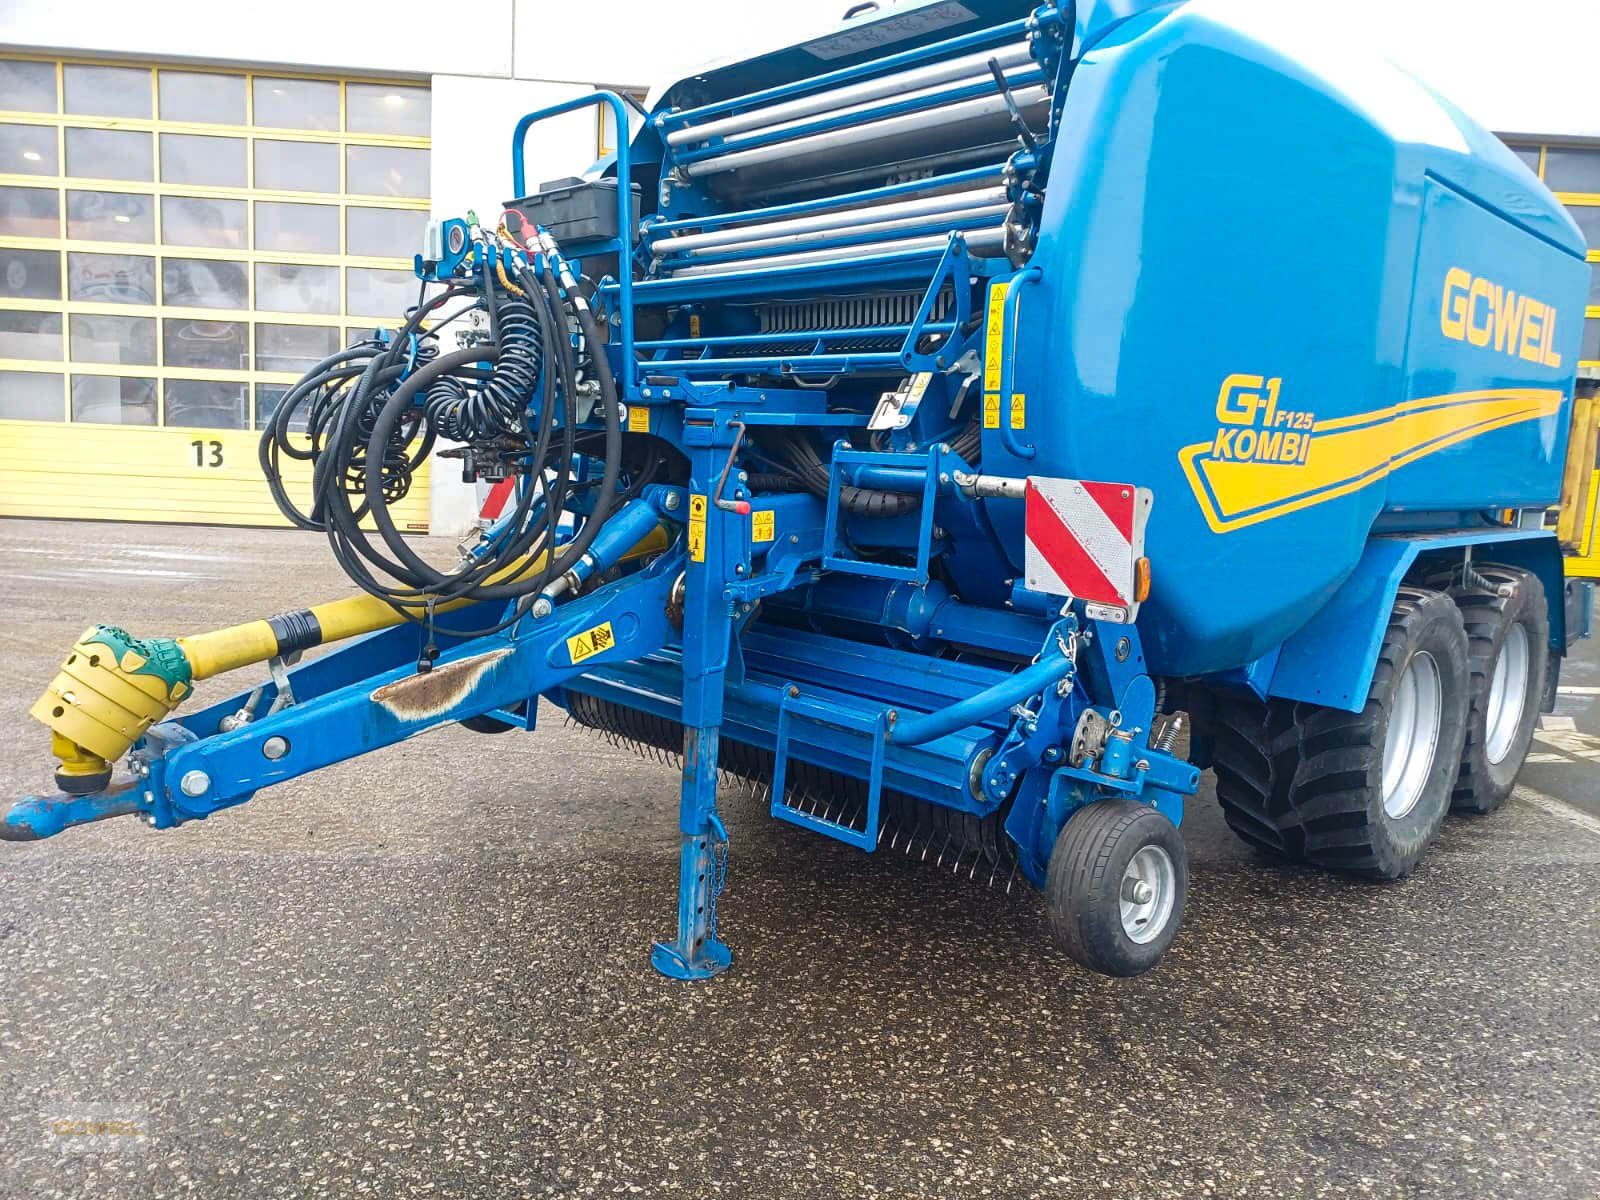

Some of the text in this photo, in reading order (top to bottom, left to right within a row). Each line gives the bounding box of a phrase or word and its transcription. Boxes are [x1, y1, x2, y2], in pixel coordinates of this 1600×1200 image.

[1275, 410, 1314, 429] F125
[192, 440, 223, 467] 13
[1213, 428, 1309, 462] KOMBI
